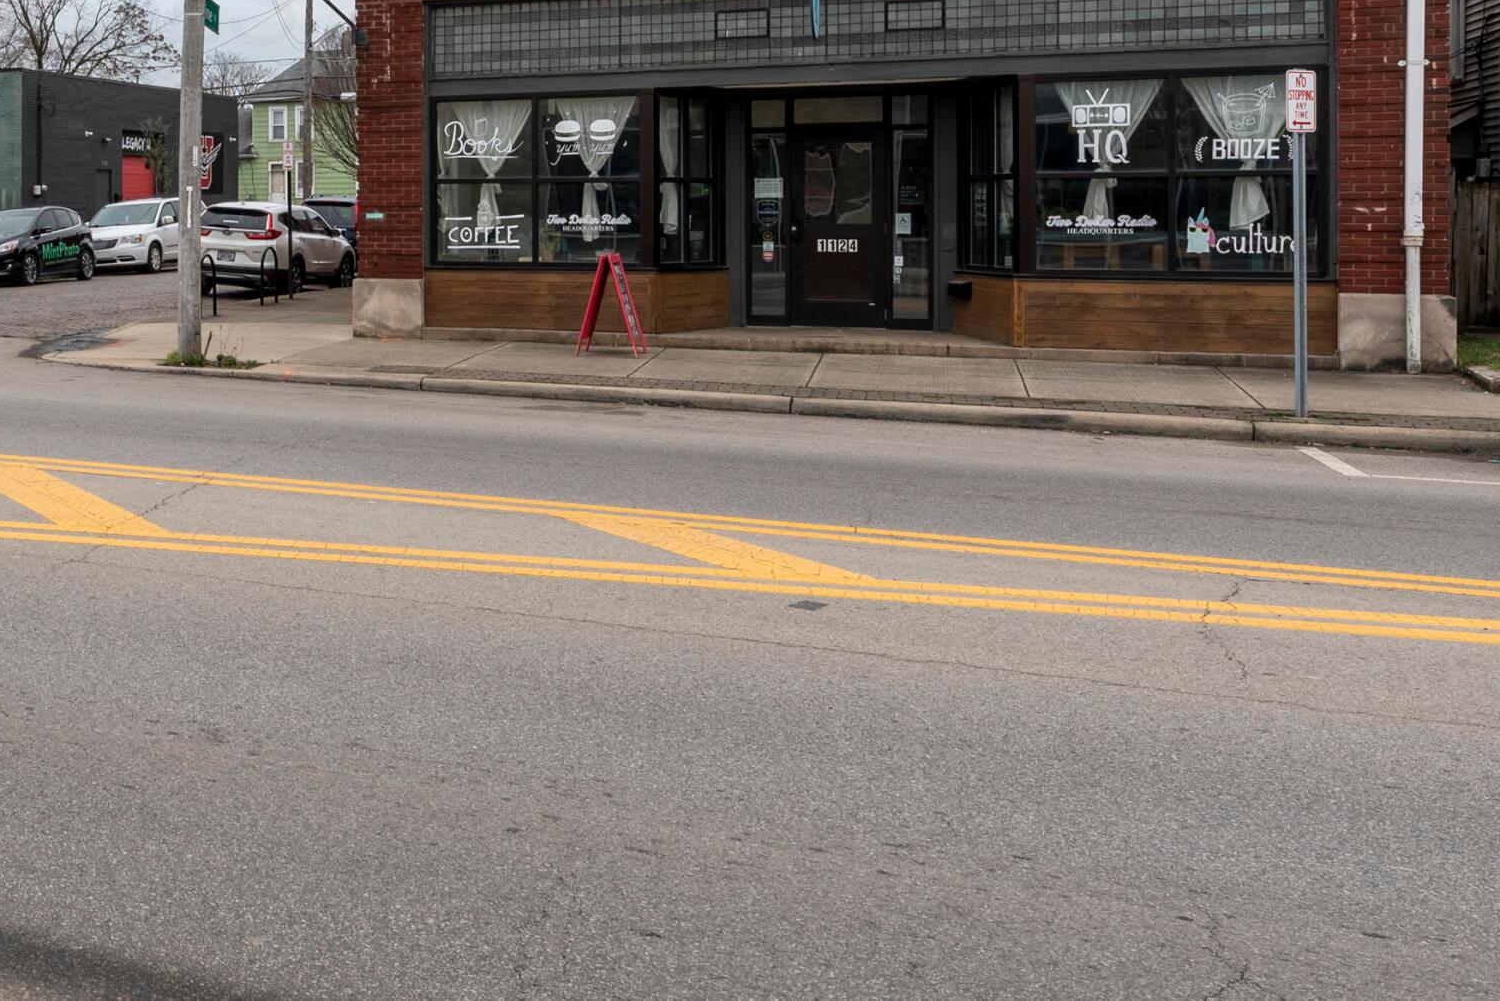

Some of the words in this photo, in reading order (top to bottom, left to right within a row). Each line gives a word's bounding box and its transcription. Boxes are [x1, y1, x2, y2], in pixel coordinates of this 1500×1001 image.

[1295, 76, 1307, 87] NO
[1288, 89, 1315, 101] STOPPING
[1295, 102, 1307, 110] ANY
[1294, 110, 1308, 119] TIME
[121, 136, 145, 151] LEGACY
[444, 120, 524, 156] Books
[1076, 128, 1130, 164] HQ
[1212, 138, 1281, 160] BOOZE
[1074, 214, 1116, 228] Dollar
[1117, 214, 1158, 228] Radio
[448, 224, 520, 244] COFFEE
[1067, 227, 1134, 235] HEADQUARTERS
[41, 241, 80, 260] MintPhoto
[818, 239, 858, 252] 1124
